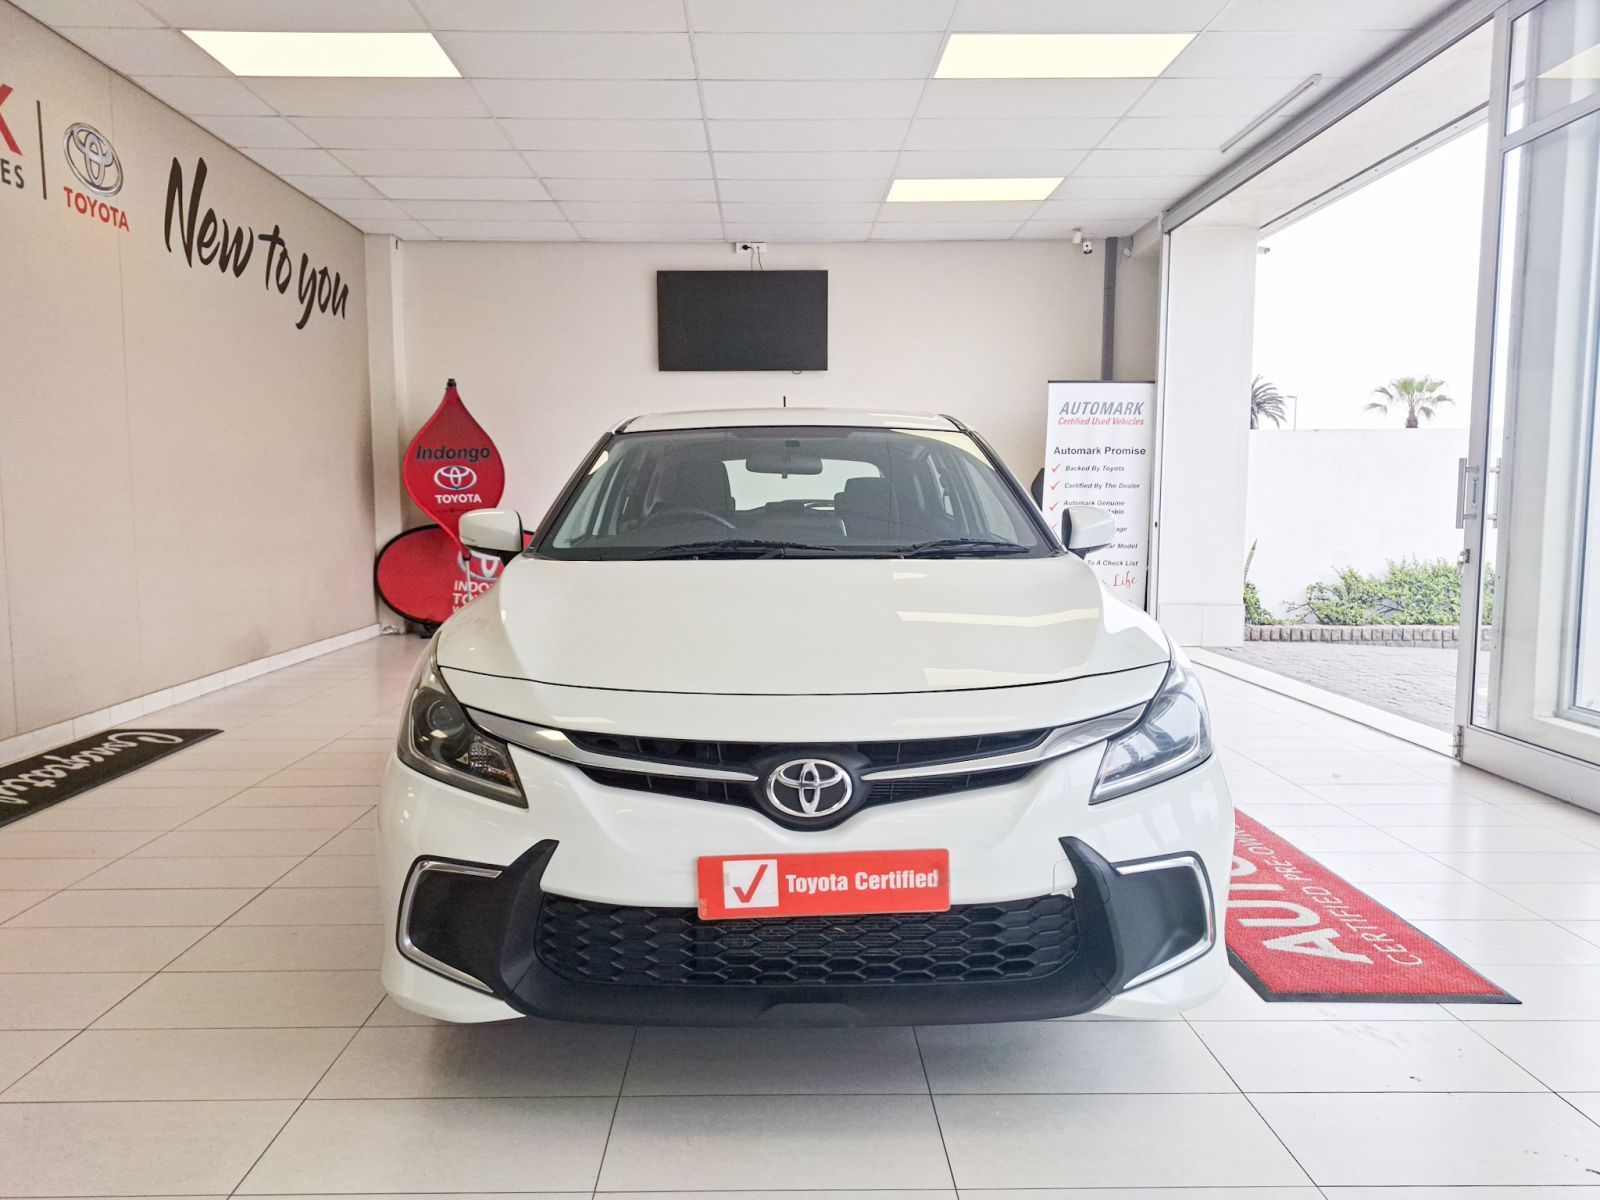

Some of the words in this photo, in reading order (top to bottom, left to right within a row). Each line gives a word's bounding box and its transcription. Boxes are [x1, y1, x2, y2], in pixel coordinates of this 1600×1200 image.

[63, 186, 130, 232] TOYOTA
[164, 156, 254, 278] New
[258, 224, 292, 294] to
[295, 252, 349, 330] you
[1059, 401, 1144, 415] AUTOMARK
[1058, 417, 1090, 426] Certified
[1092, 417, 1110, 426] Used
[1112, 417, 1145, 426] Vehicles
[415, 445, 491, 462] Indongo
[1053, 446, 1102, 456] Automark
[1104, 446, 1147, 456] Promise
[1091, 465, 1100, 473] By
[1102, 465, 1125, 473] Toyota
[1093, 482, 1102, 490] By
[435, 494, 482, 504] TOYOTA
[1102, 559, 1123, 567] Check
[1125, 559, 1139, 567] List
[785, 874, 849, 895] Toyota
[855, 869, 939, 891] Certified
[1302, 885, 1424, 967] CERTIFIED
